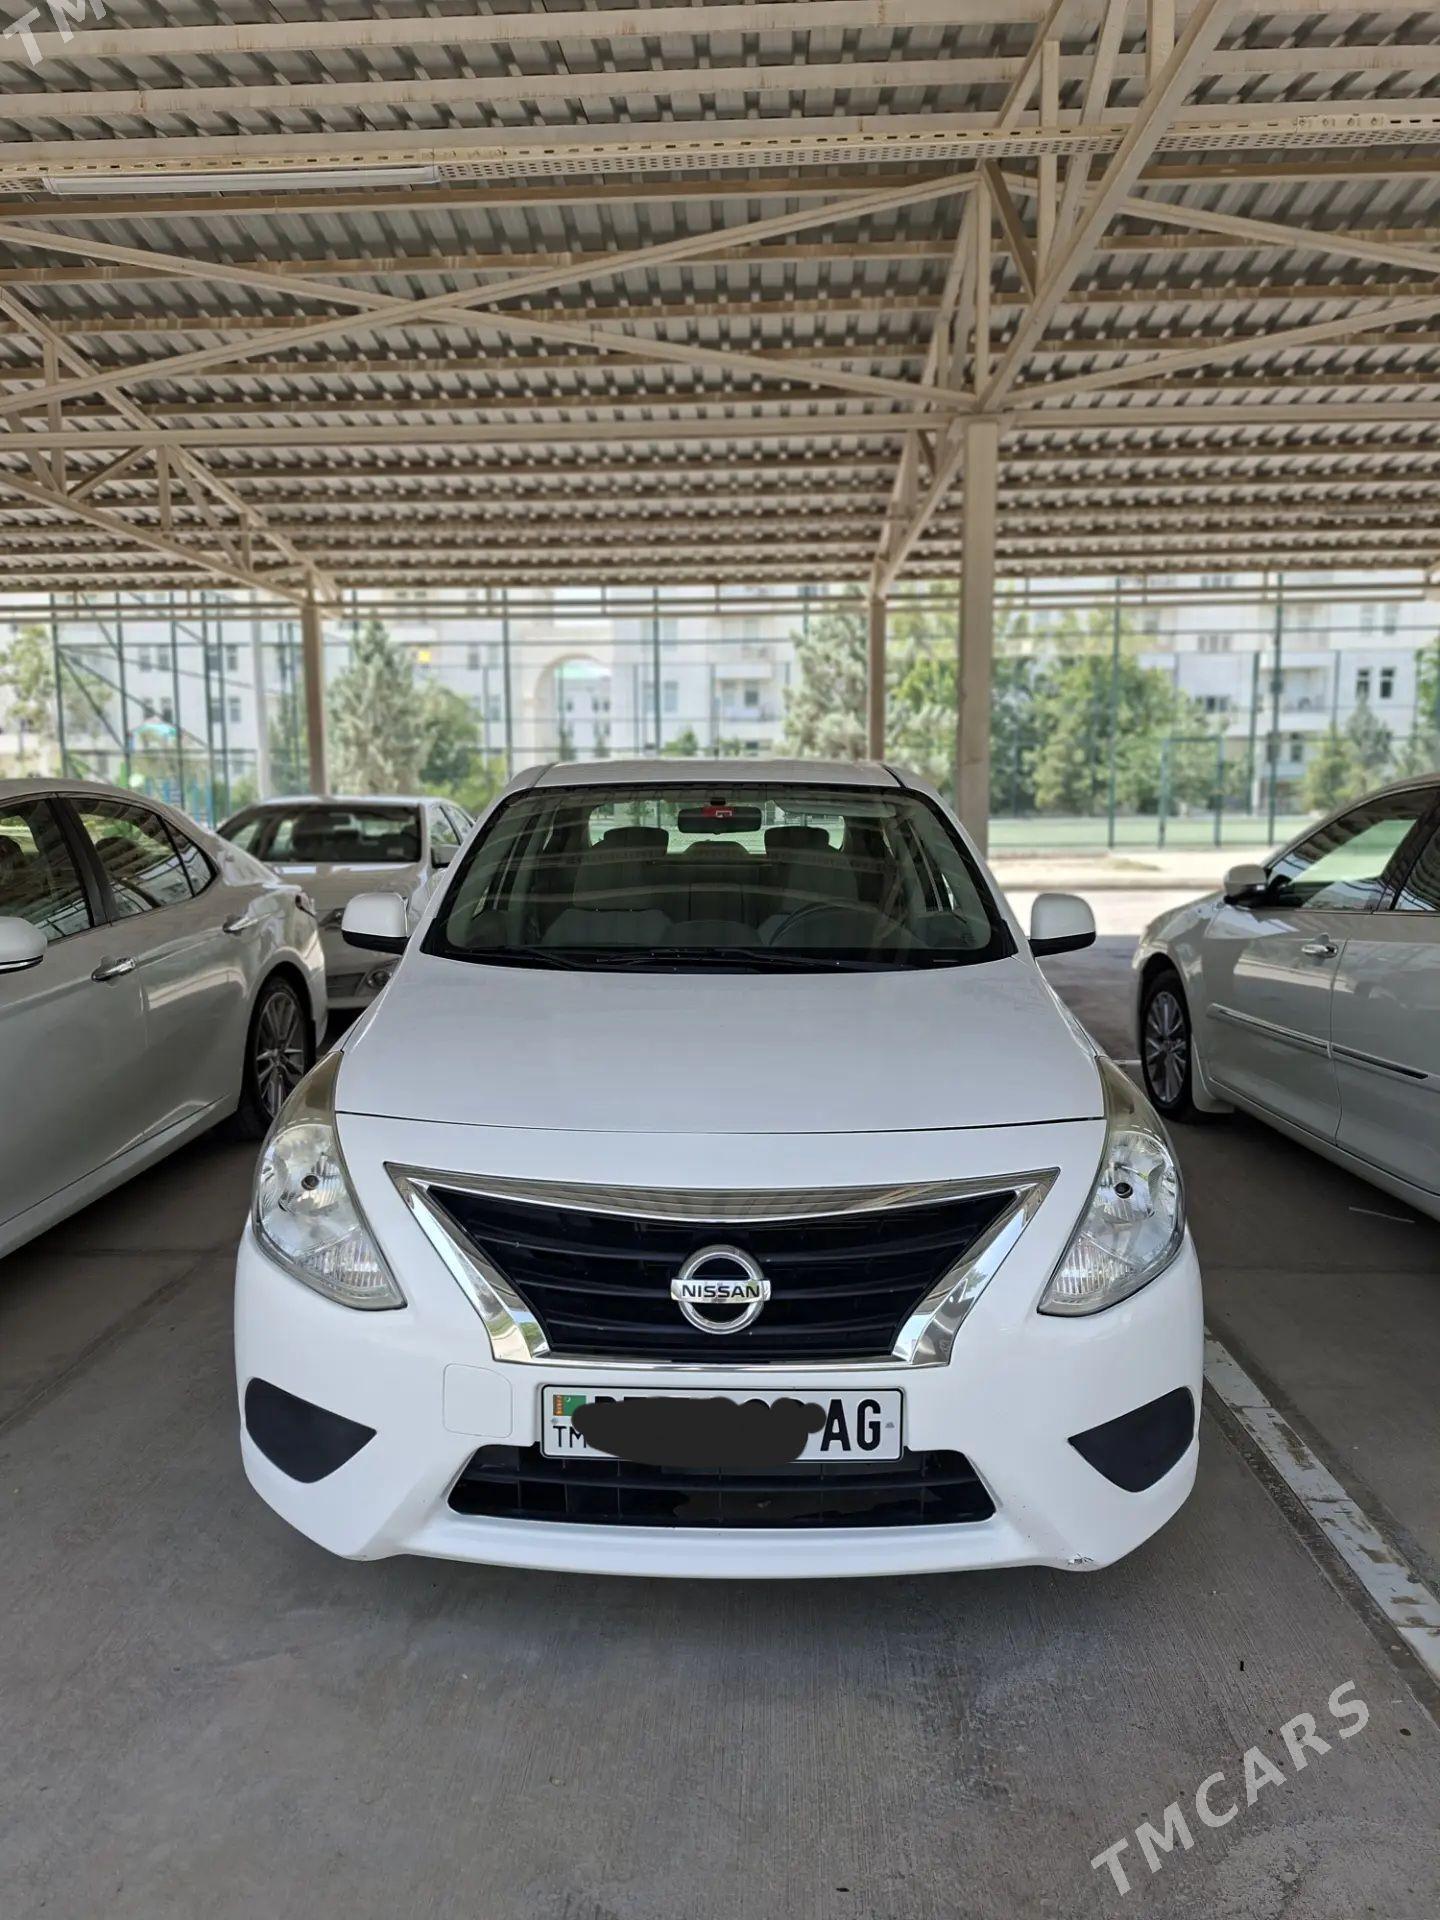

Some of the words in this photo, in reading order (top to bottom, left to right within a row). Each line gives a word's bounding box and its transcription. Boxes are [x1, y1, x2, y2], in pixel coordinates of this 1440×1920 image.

[682, 1284, 760, 1298] NISSAN
[820, 1398, 881, 1451] AG
[553, 1426, 587, 1448] TM
